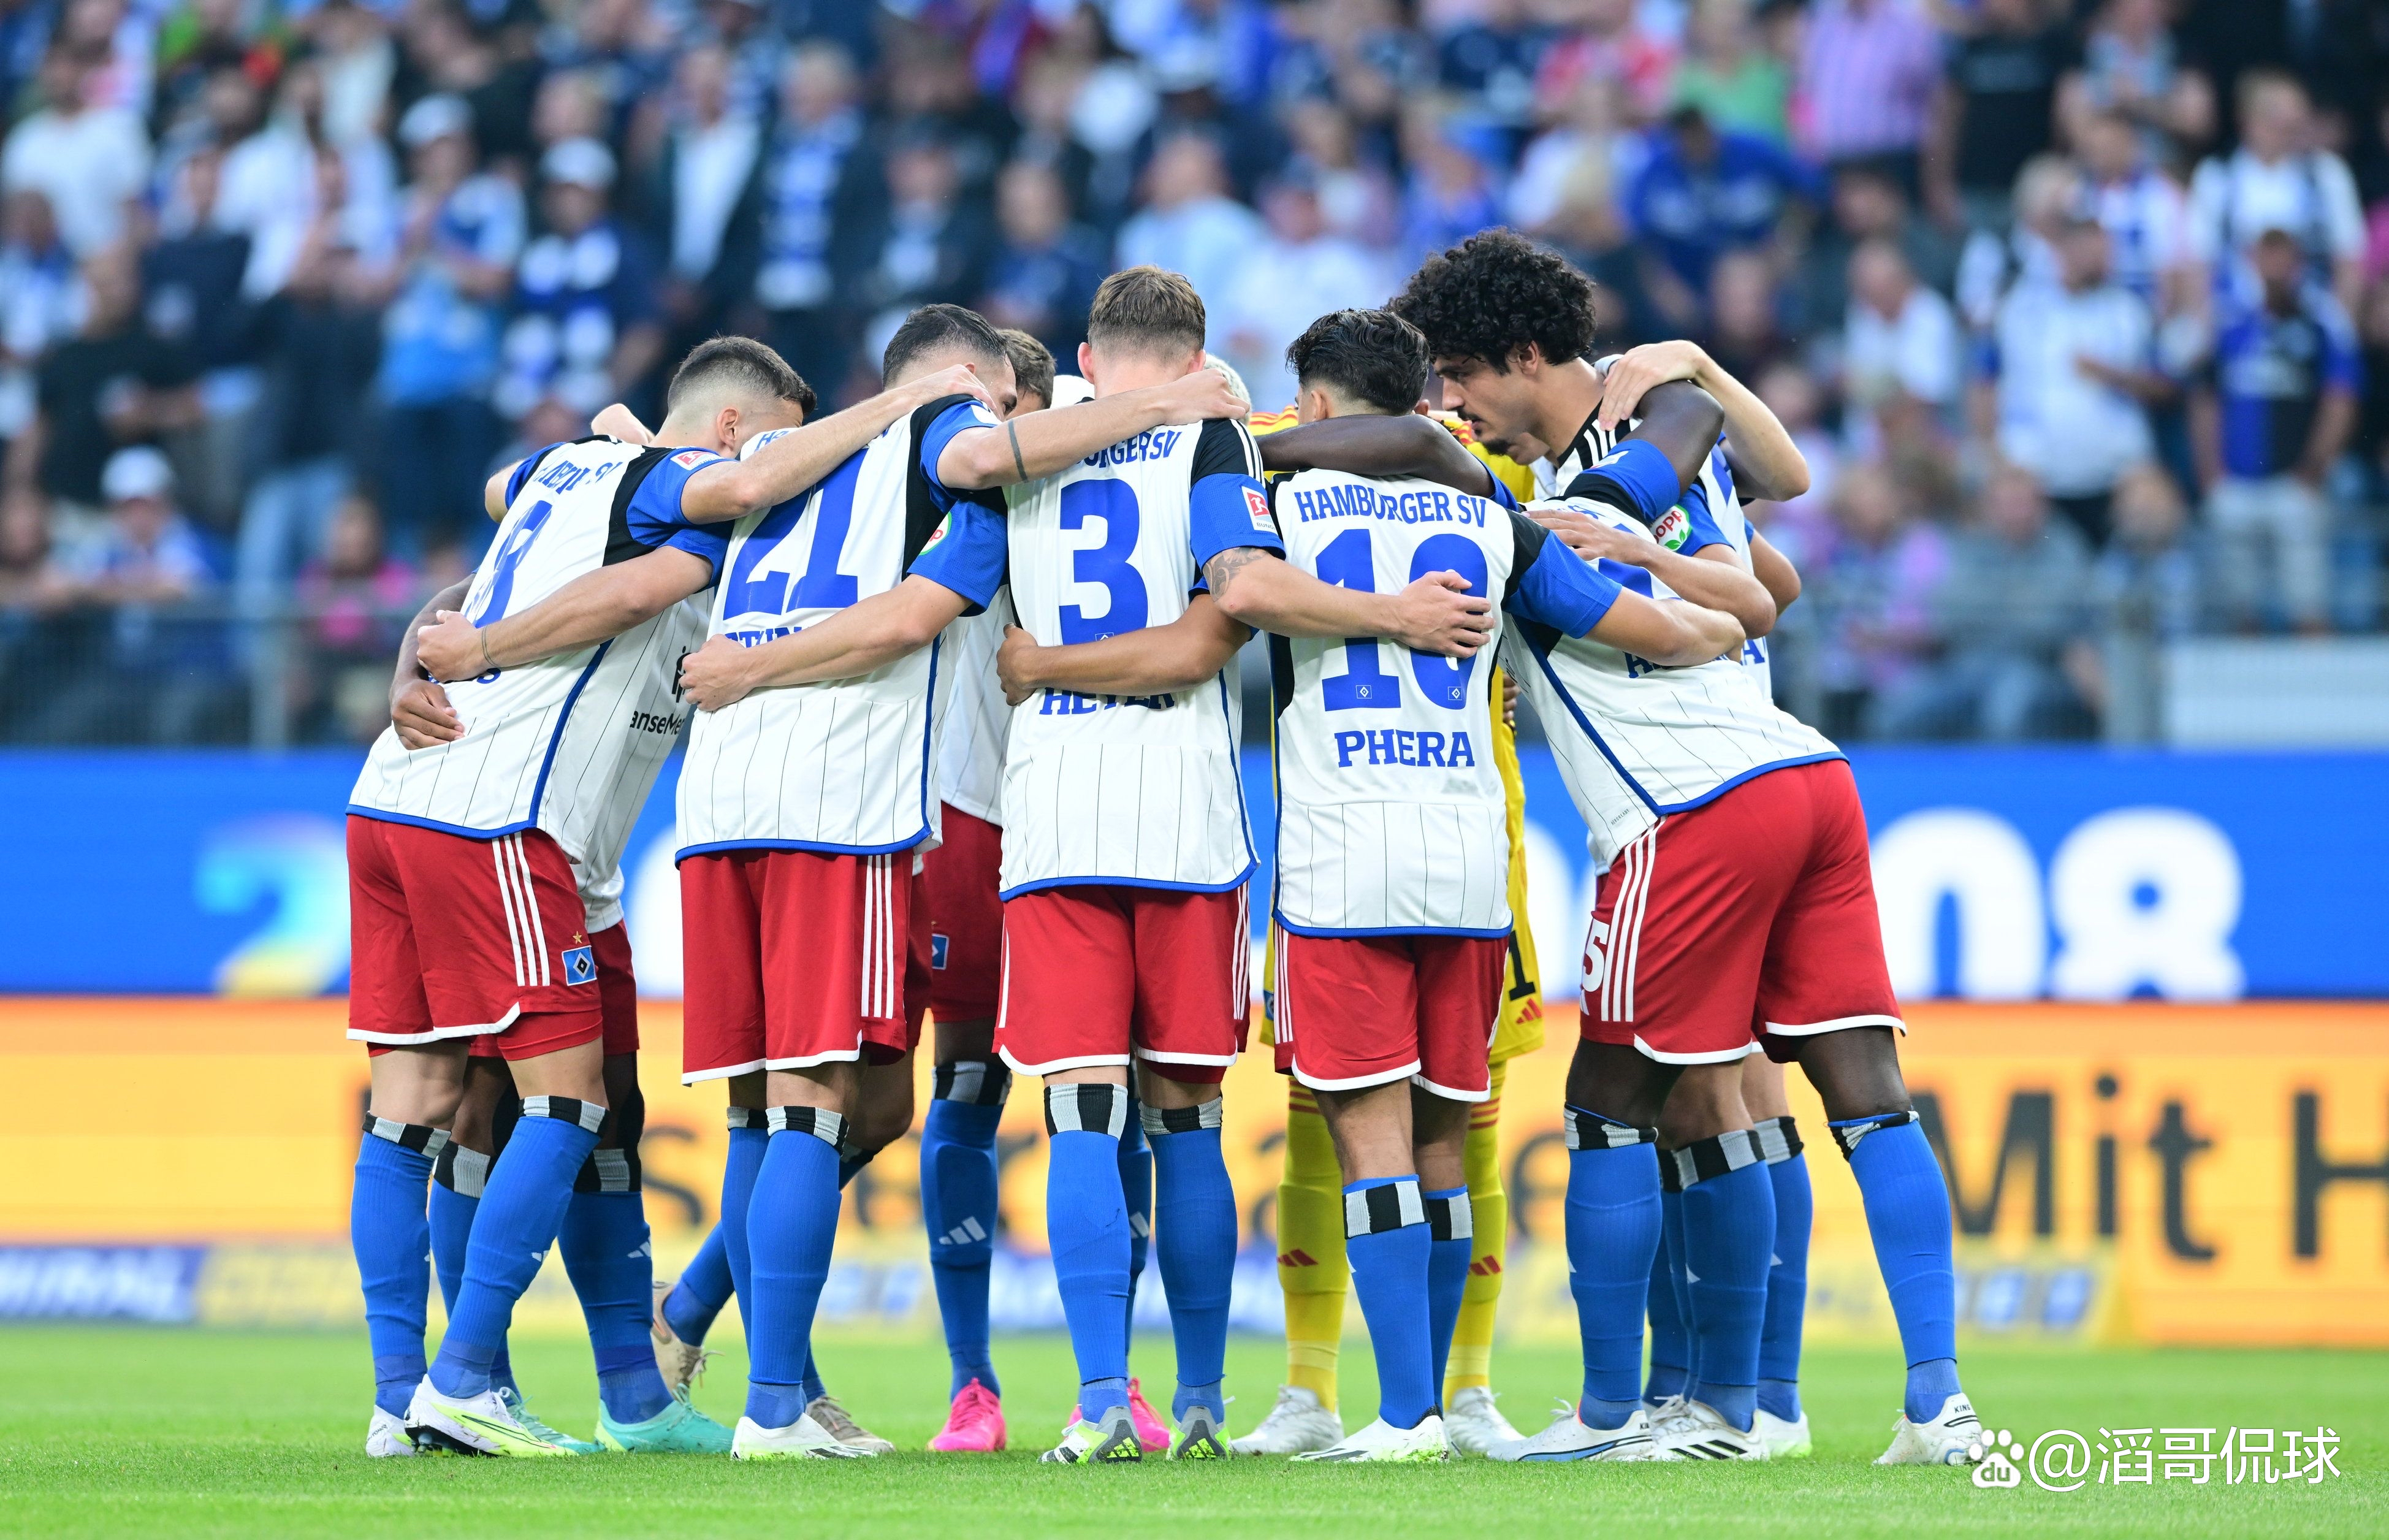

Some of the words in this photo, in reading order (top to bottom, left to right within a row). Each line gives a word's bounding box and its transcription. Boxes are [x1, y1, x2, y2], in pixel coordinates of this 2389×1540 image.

[1149, 430, 1183, 460] SV
[1294, 484, 1453, 524] HAMBURGER
[1458, 494, 1487, 528] SV
[1655, 510, 1682, 544] opp
[1059, 478, 1148, 646] 3
[1335, 729, 1476, 768] PHERA
[1508, 930, 1536, 1001] 1
[1907, 1068, 2220, 1264] Mit
